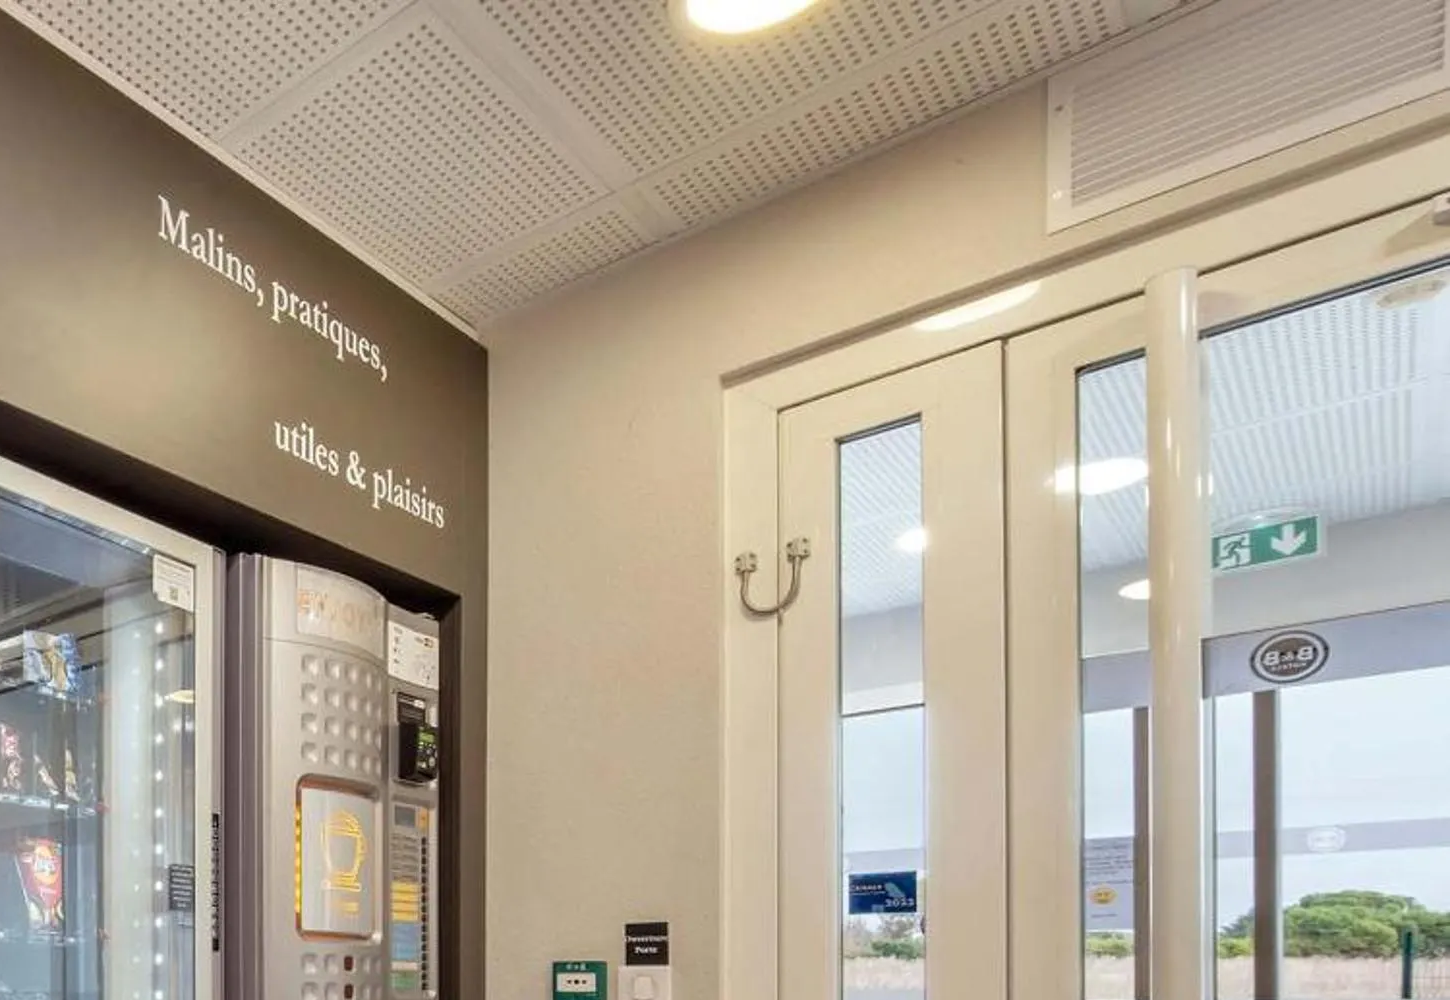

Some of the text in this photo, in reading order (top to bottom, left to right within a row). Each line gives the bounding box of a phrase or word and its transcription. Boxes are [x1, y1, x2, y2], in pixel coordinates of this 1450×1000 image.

[157, 193, 389, 383] Malins, pratiques,
[274, 420, 445, 529] utiles & plaisirs
